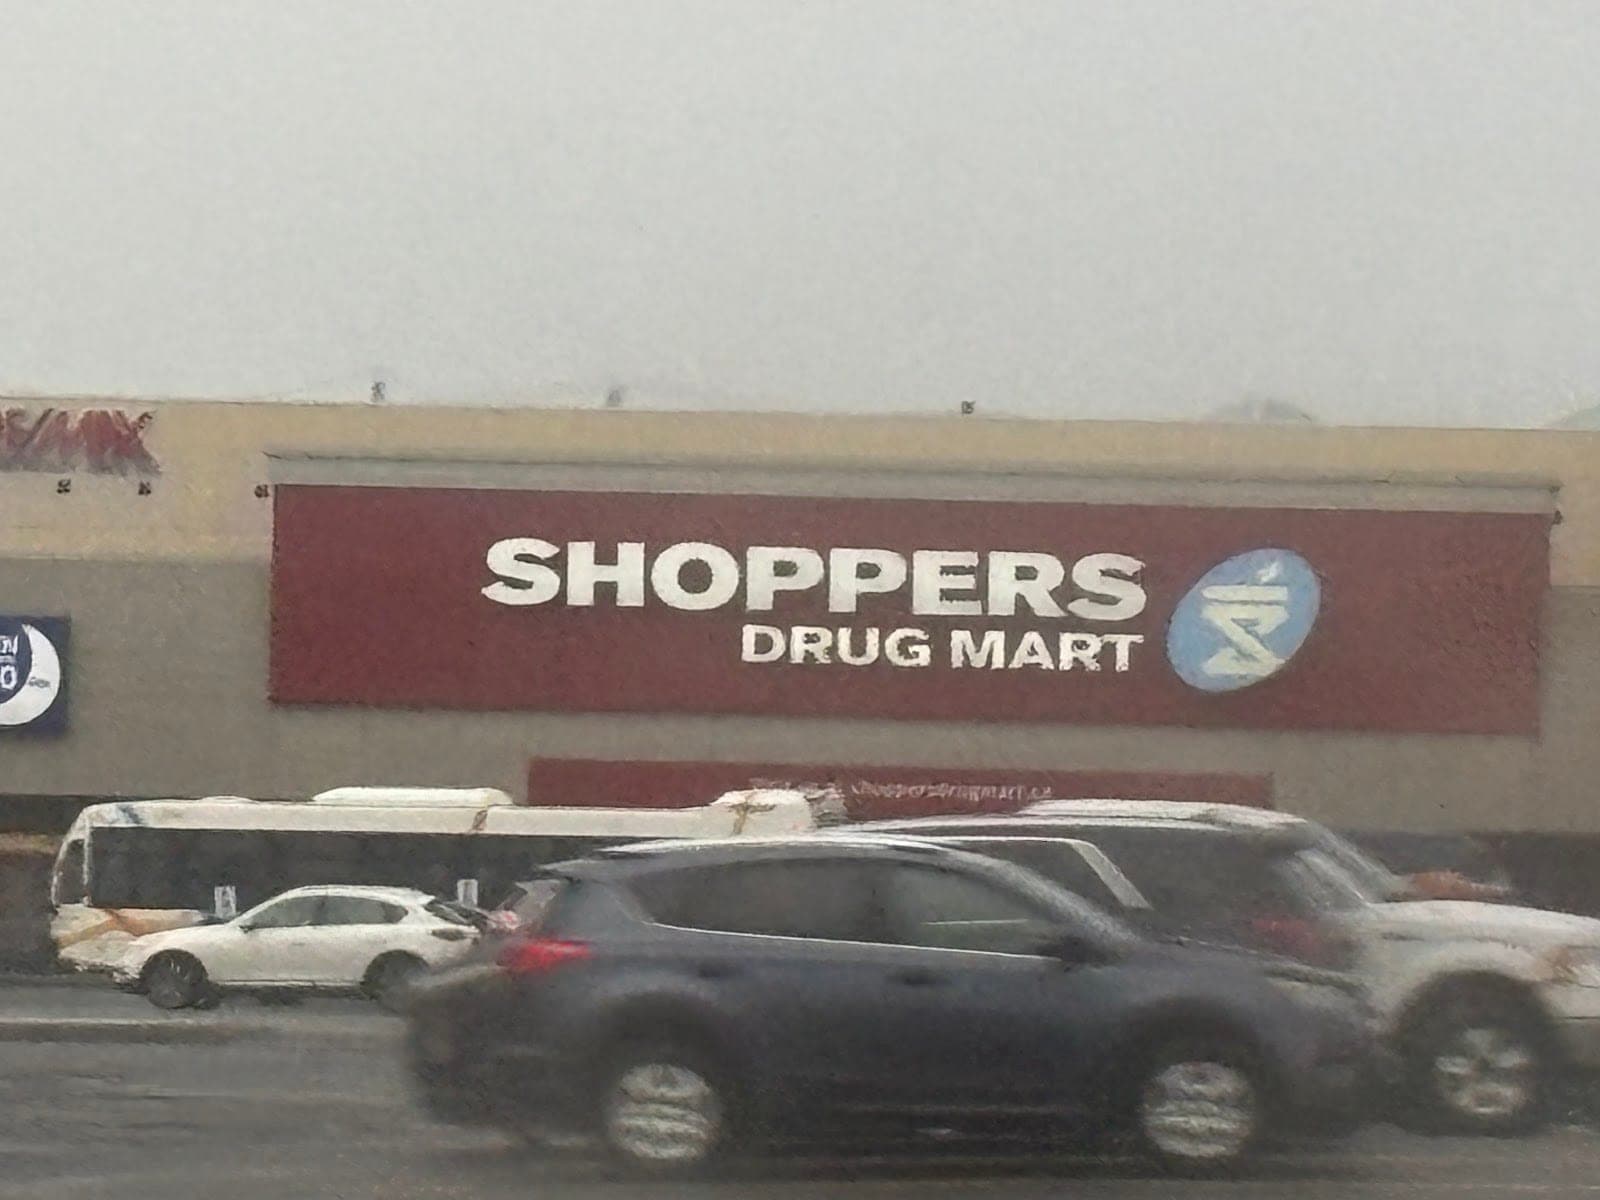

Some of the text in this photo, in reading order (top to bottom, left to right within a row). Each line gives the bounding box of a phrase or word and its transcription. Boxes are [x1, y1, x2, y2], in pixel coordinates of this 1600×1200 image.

[481, 538, 1147, 620] SHOPPERS
[741, 624, 1144, 672] DRUG MART
